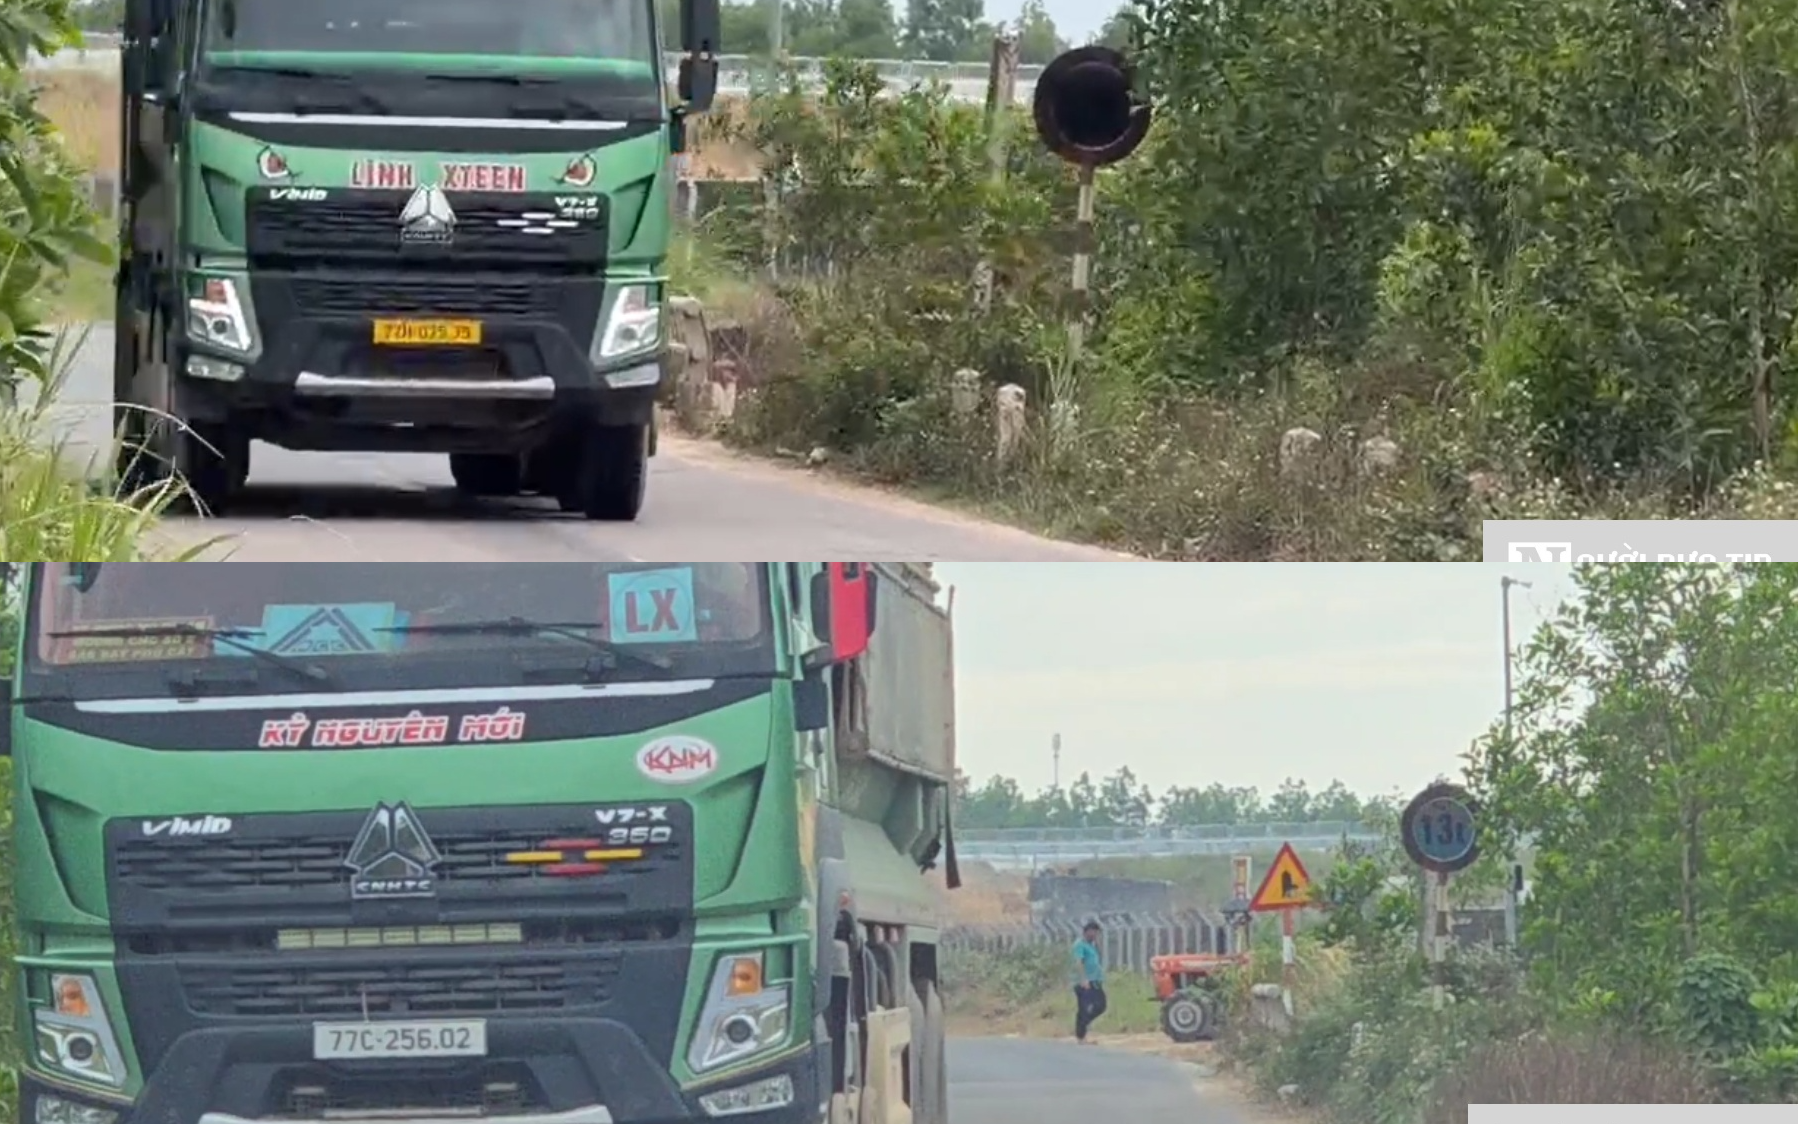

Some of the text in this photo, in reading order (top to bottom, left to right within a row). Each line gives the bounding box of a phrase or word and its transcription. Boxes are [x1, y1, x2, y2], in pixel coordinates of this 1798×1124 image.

[624, 588, 680, 633] LX
[258, 706, 526, 747] KỶ NGUYÊN MỚI
[595, 806, 667, 824] V7-X
[608, 826, 672, 845] 360
[329, 1027, 470, 1051] 77C-256.02
